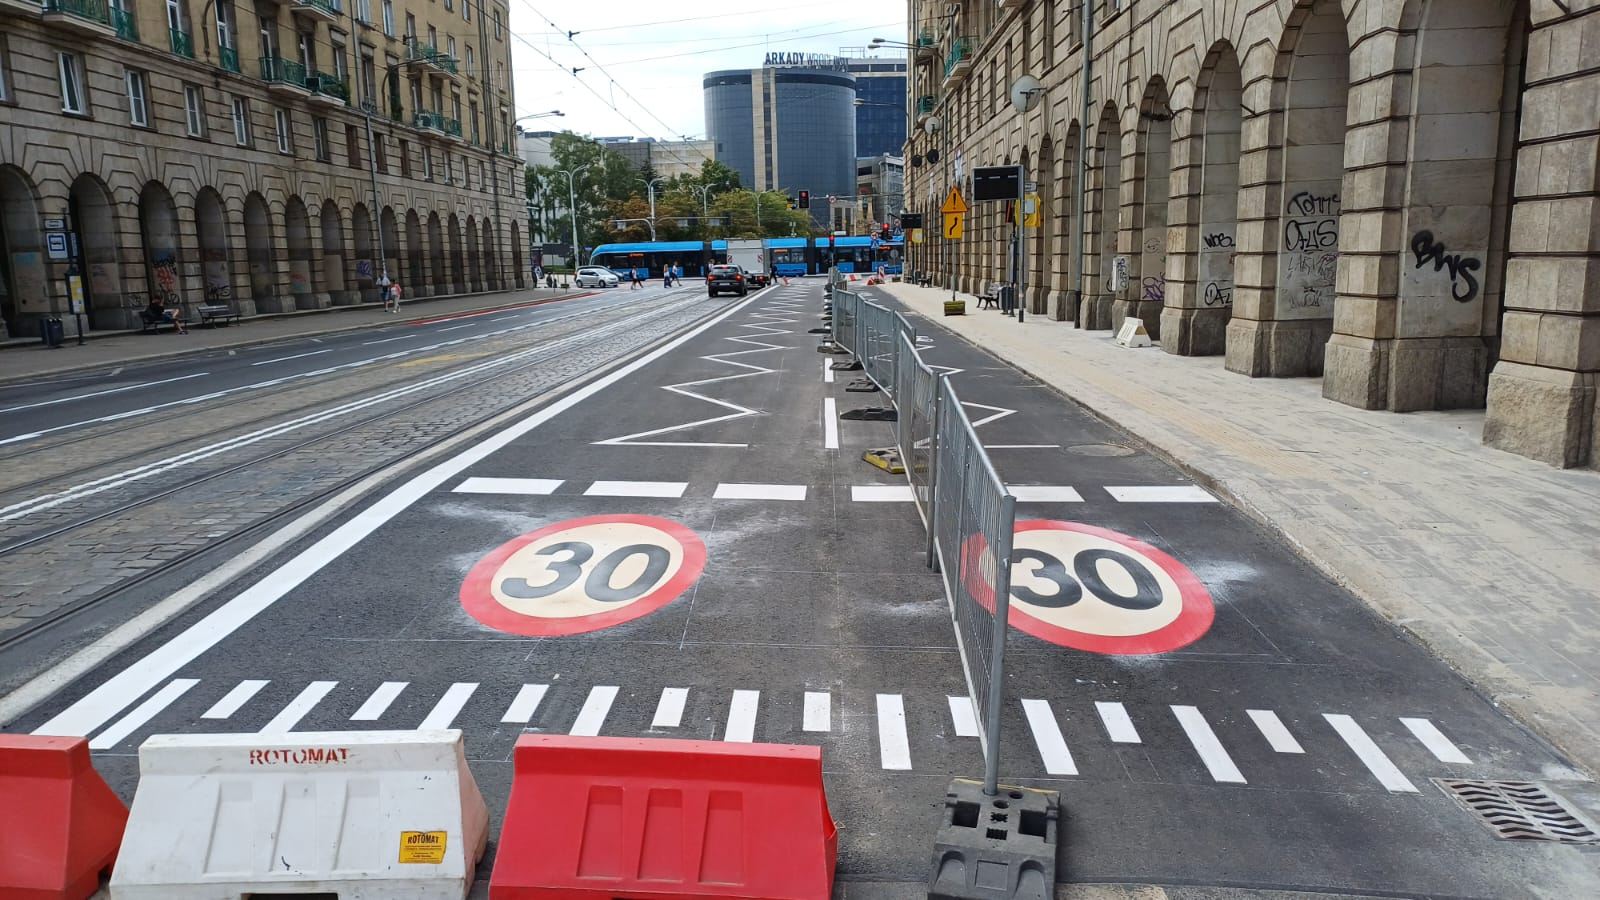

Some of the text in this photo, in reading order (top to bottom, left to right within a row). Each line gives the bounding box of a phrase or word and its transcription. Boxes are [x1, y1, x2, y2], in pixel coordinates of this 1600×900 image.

[765, 52, 805, 65] ARKADY
[501, 541, 671, 602] 30
[1009, 548, 1164, 610] 30
[249, 748, 350, 764] ROTOMAT
[407, 834, 441, 844] ROTOMAT
